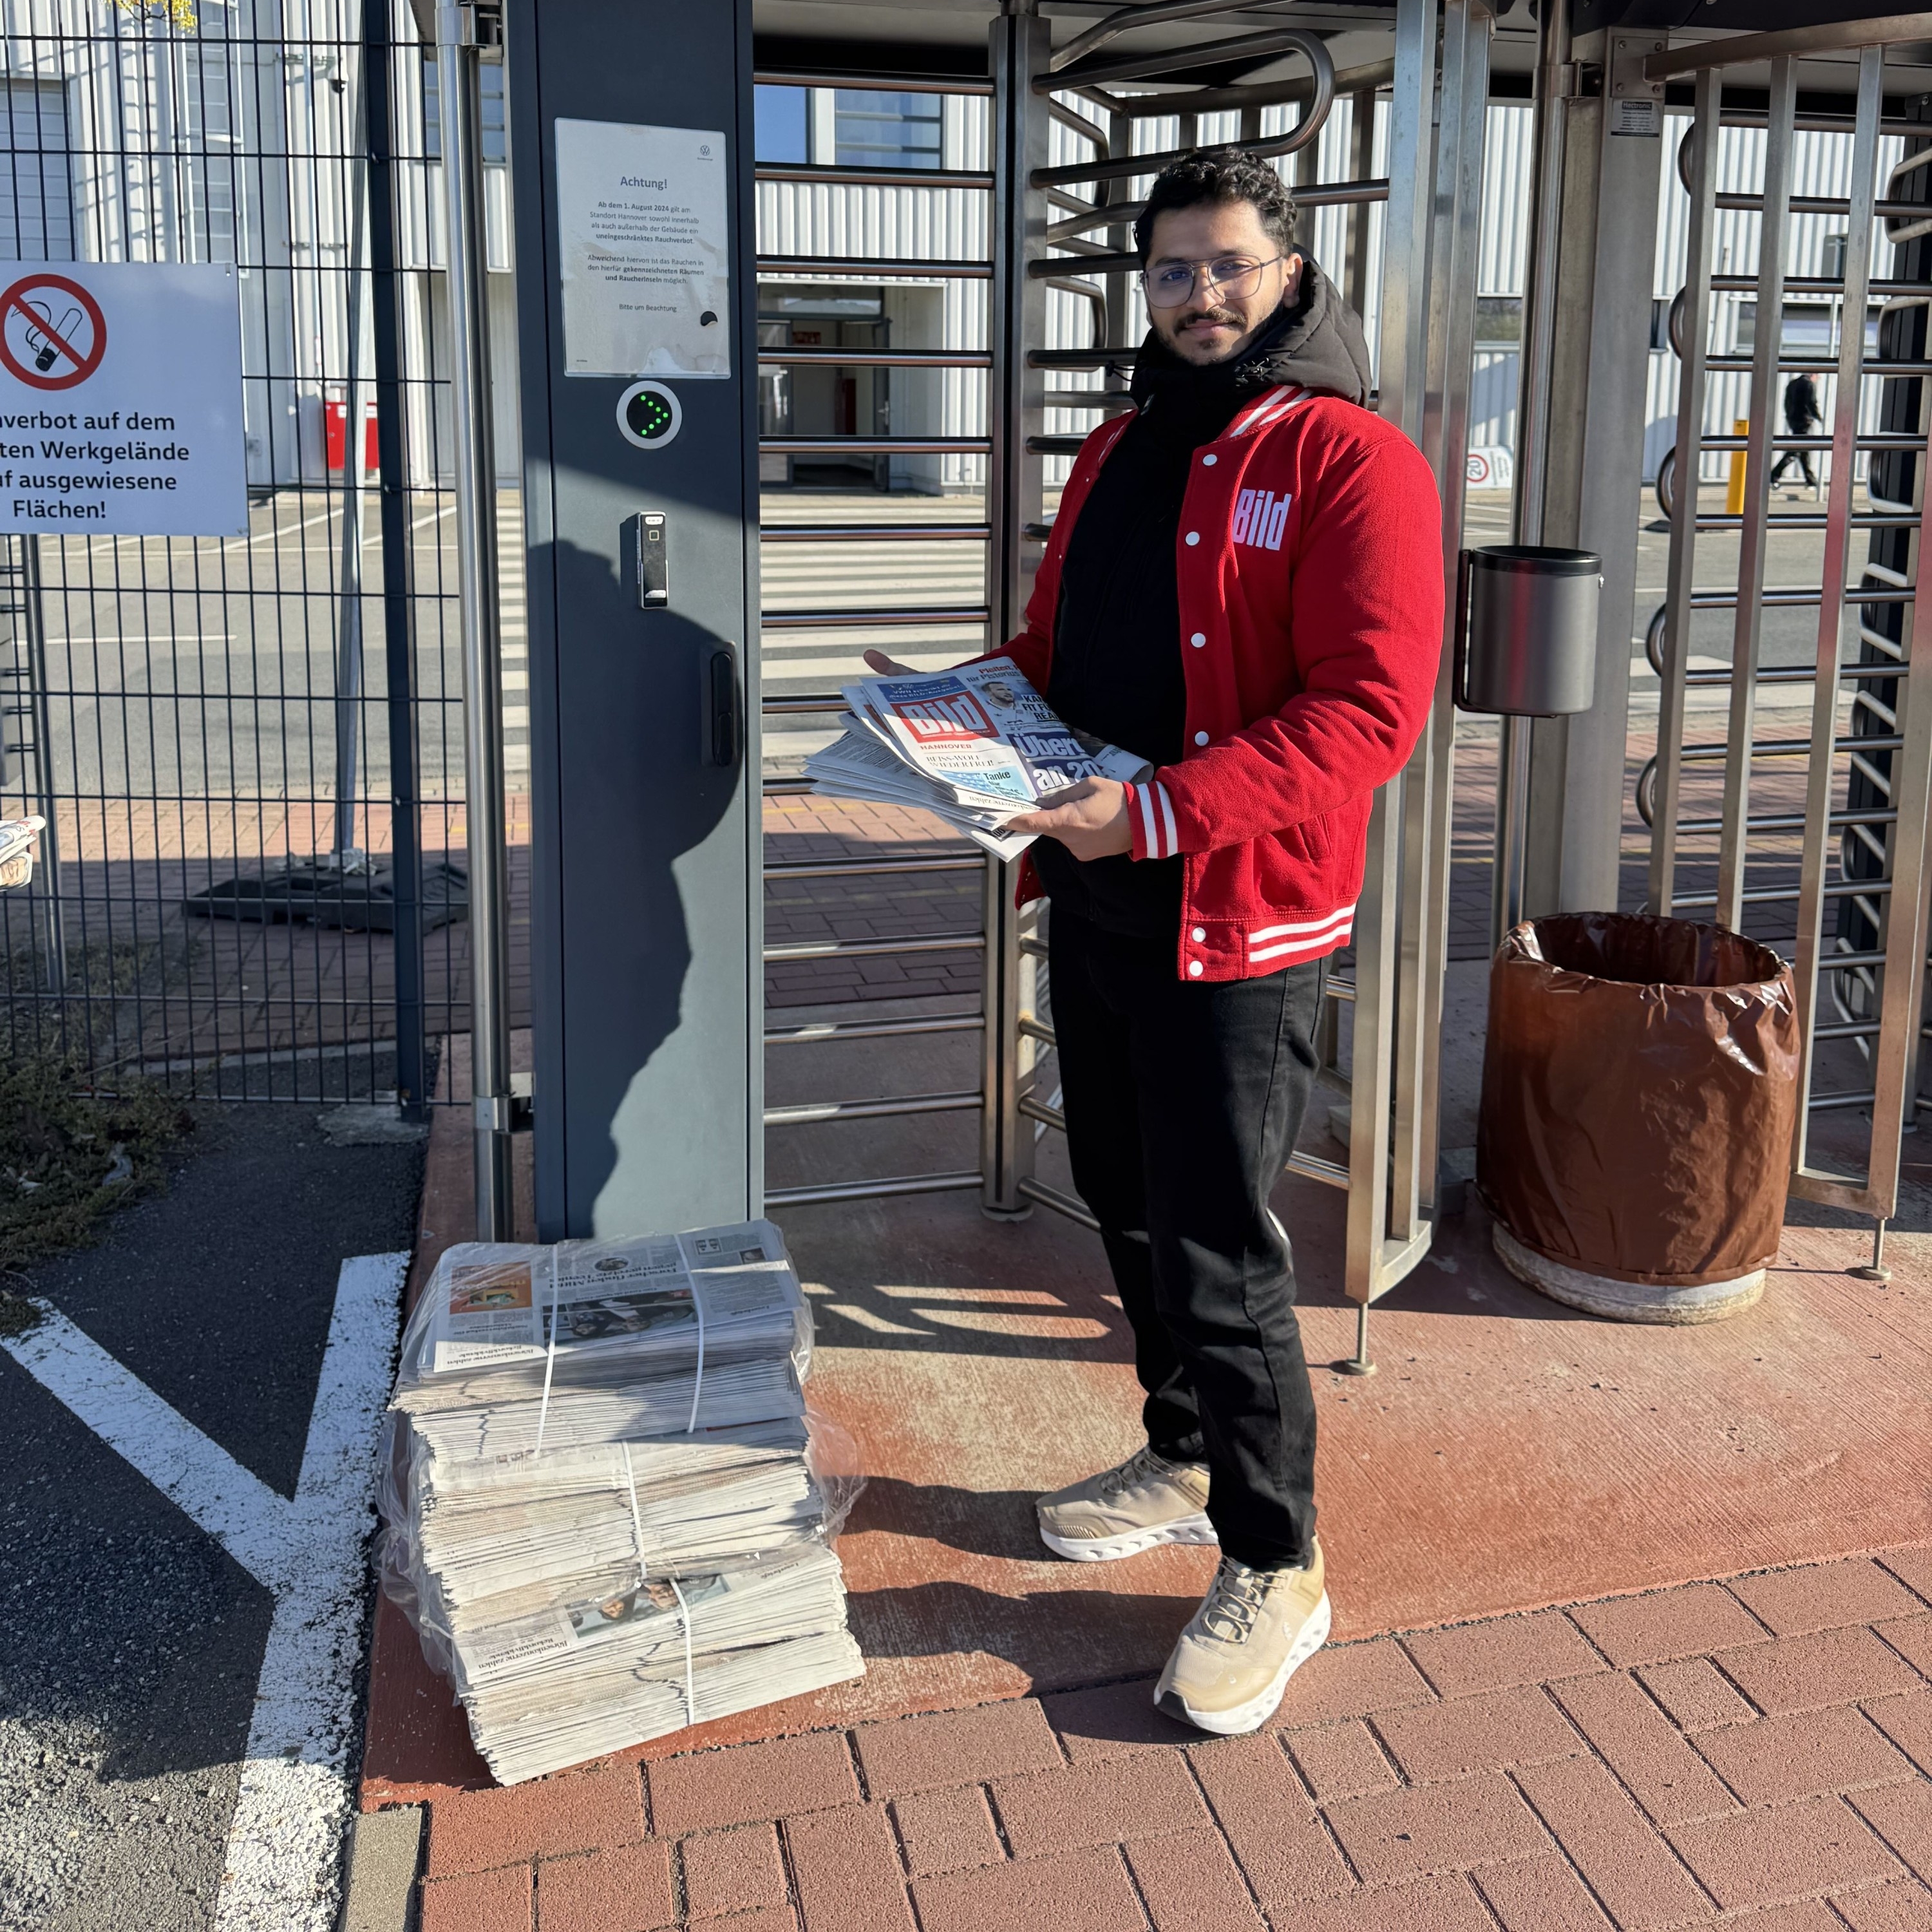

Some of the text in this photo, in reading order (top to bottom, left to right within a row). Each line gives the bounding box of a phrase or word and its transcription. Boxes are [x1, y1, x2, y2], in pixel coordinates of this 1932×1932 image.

[620, 176, 667, 191] Achtung!
[596, 232, 695, 244] uneingeschränktes Rauchverbot.
[623, 266, 677, 274] gekennzeichneten
[646, 305, 677, 313] Beachtung
[0, 411, 175, 430] verbot auf dem
[41, 441, 189, 464] Werkgelände
[19, 471, 177, 493] ausgewiesene
[14, 500, 106, 518] Flächen!
[1233, 488, 1292, 551] Bild
[900, 695, 989, 735] Bild
[1021, 703, 1037, 712] FIT
[983, 771, 1011, 781] Tanke
[1033, 766, 1071, 791] an
[549, 1279, 585, 1289] Mittl
[478, 1658, 505, 1669] zahlen
